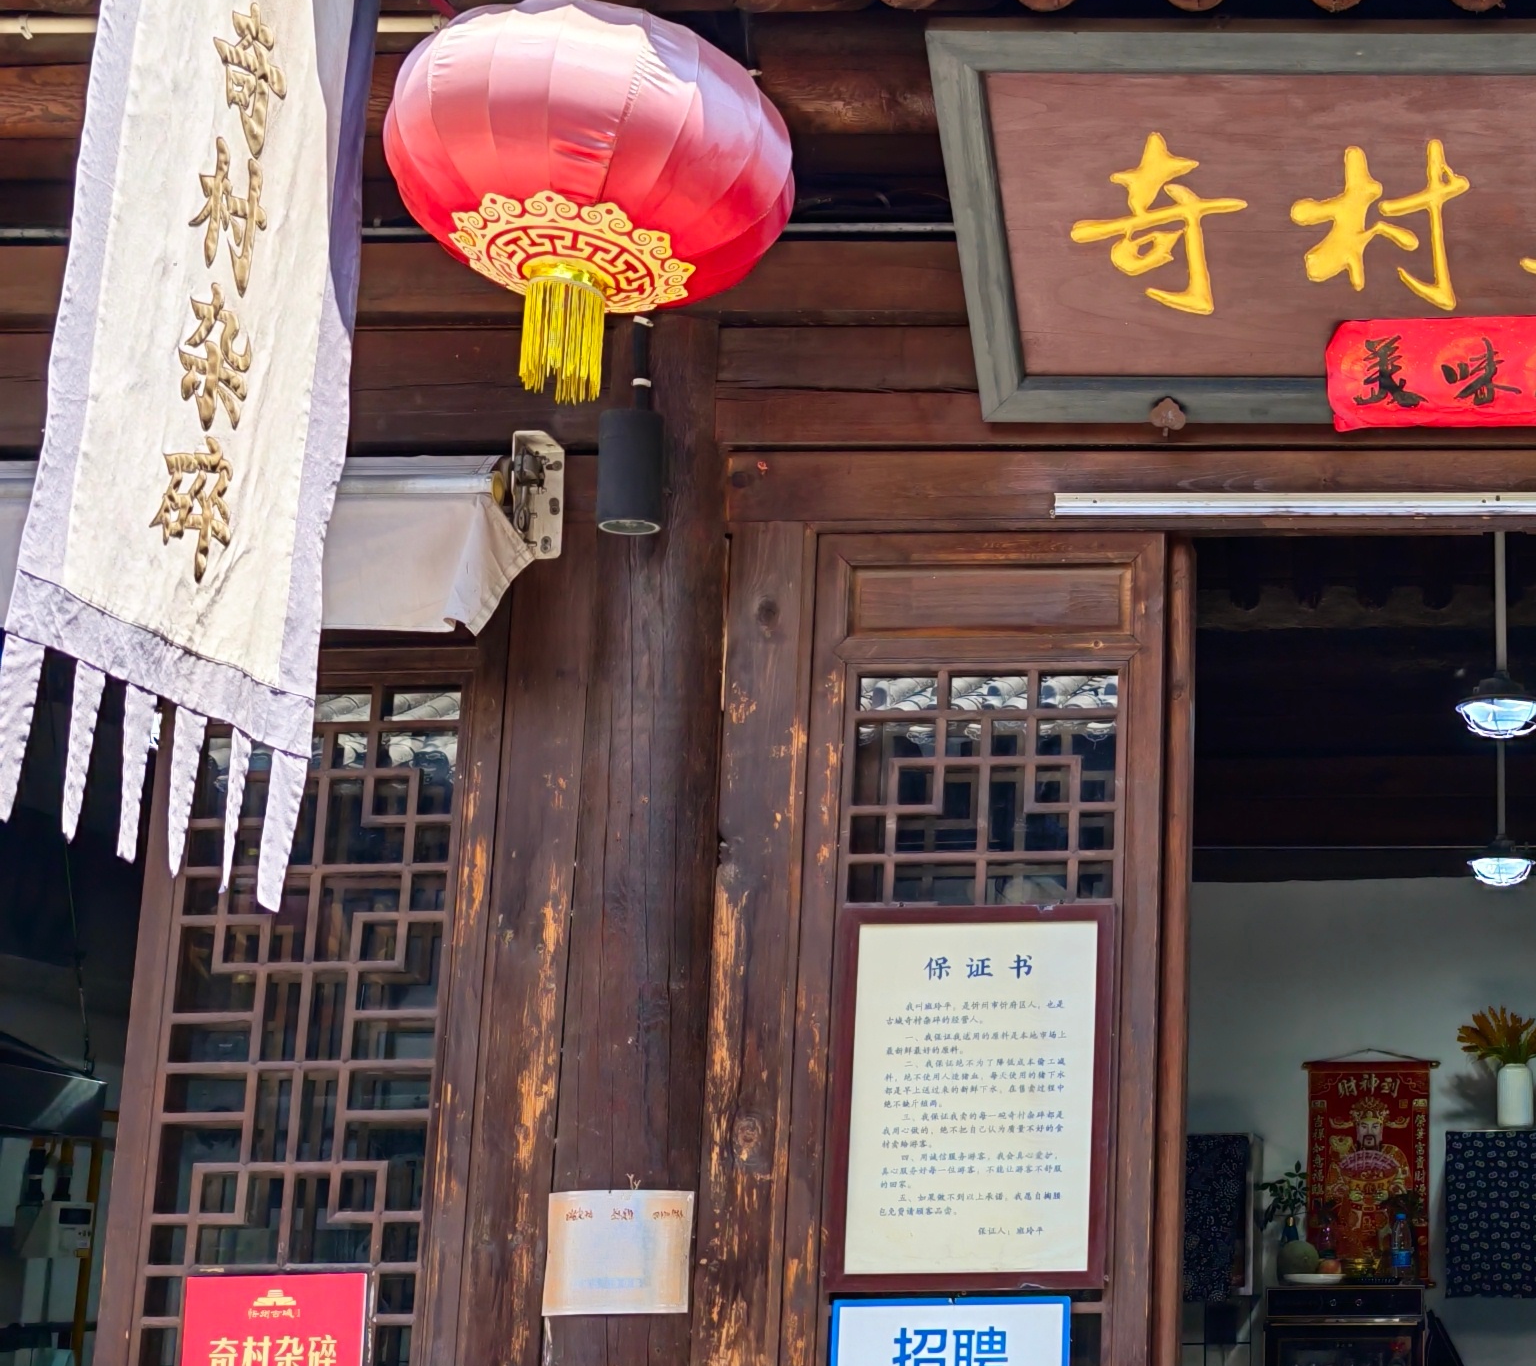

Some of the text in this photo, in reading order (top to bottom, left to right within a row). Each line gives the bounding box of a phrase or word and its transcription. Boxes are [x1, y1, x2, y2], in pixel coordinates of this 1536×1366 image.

[148, 1, 290, 584] 奇村杂碎
[923, 954, 1034, 980] 保证书
[1337, 1073, 1400, 1099] 財神到
